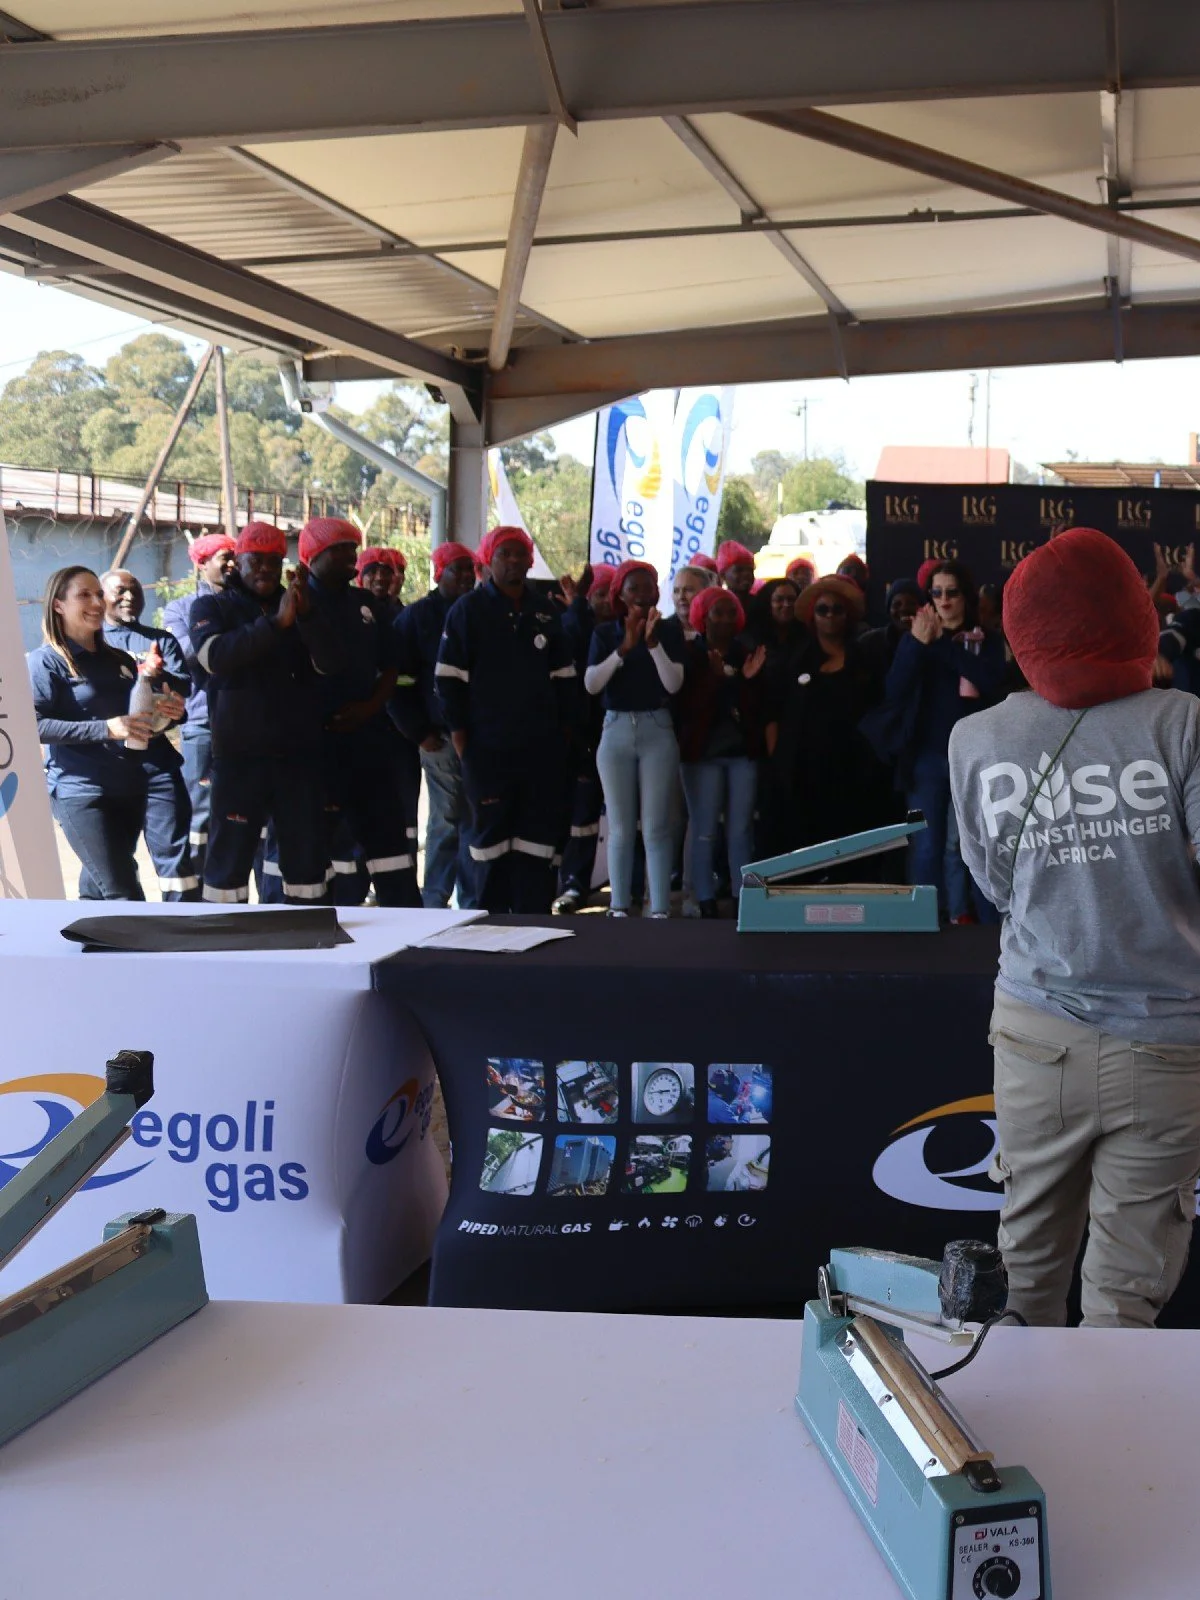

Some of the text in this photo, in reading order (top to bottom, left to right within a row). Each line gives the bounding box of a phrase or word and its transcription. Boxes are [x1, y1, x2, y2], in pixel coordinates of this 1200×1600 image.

[596, 528, 622, 567] ga
[617, 500, 646, 564] ego
[683, 496, 709, 567] ego
[997, 813, 1171, 856] AGAINST HUNGER
[1046, 844, 1117, 868] AFRICA
[132, 1100, 275, 1163] egoli
[205, 1161, 309, 1213] gas
[561, 1222, 592, 1234] GAS
[959, 1543, 988, 1554] SEALER
[990, 1525, 1019, 1537] VALA
